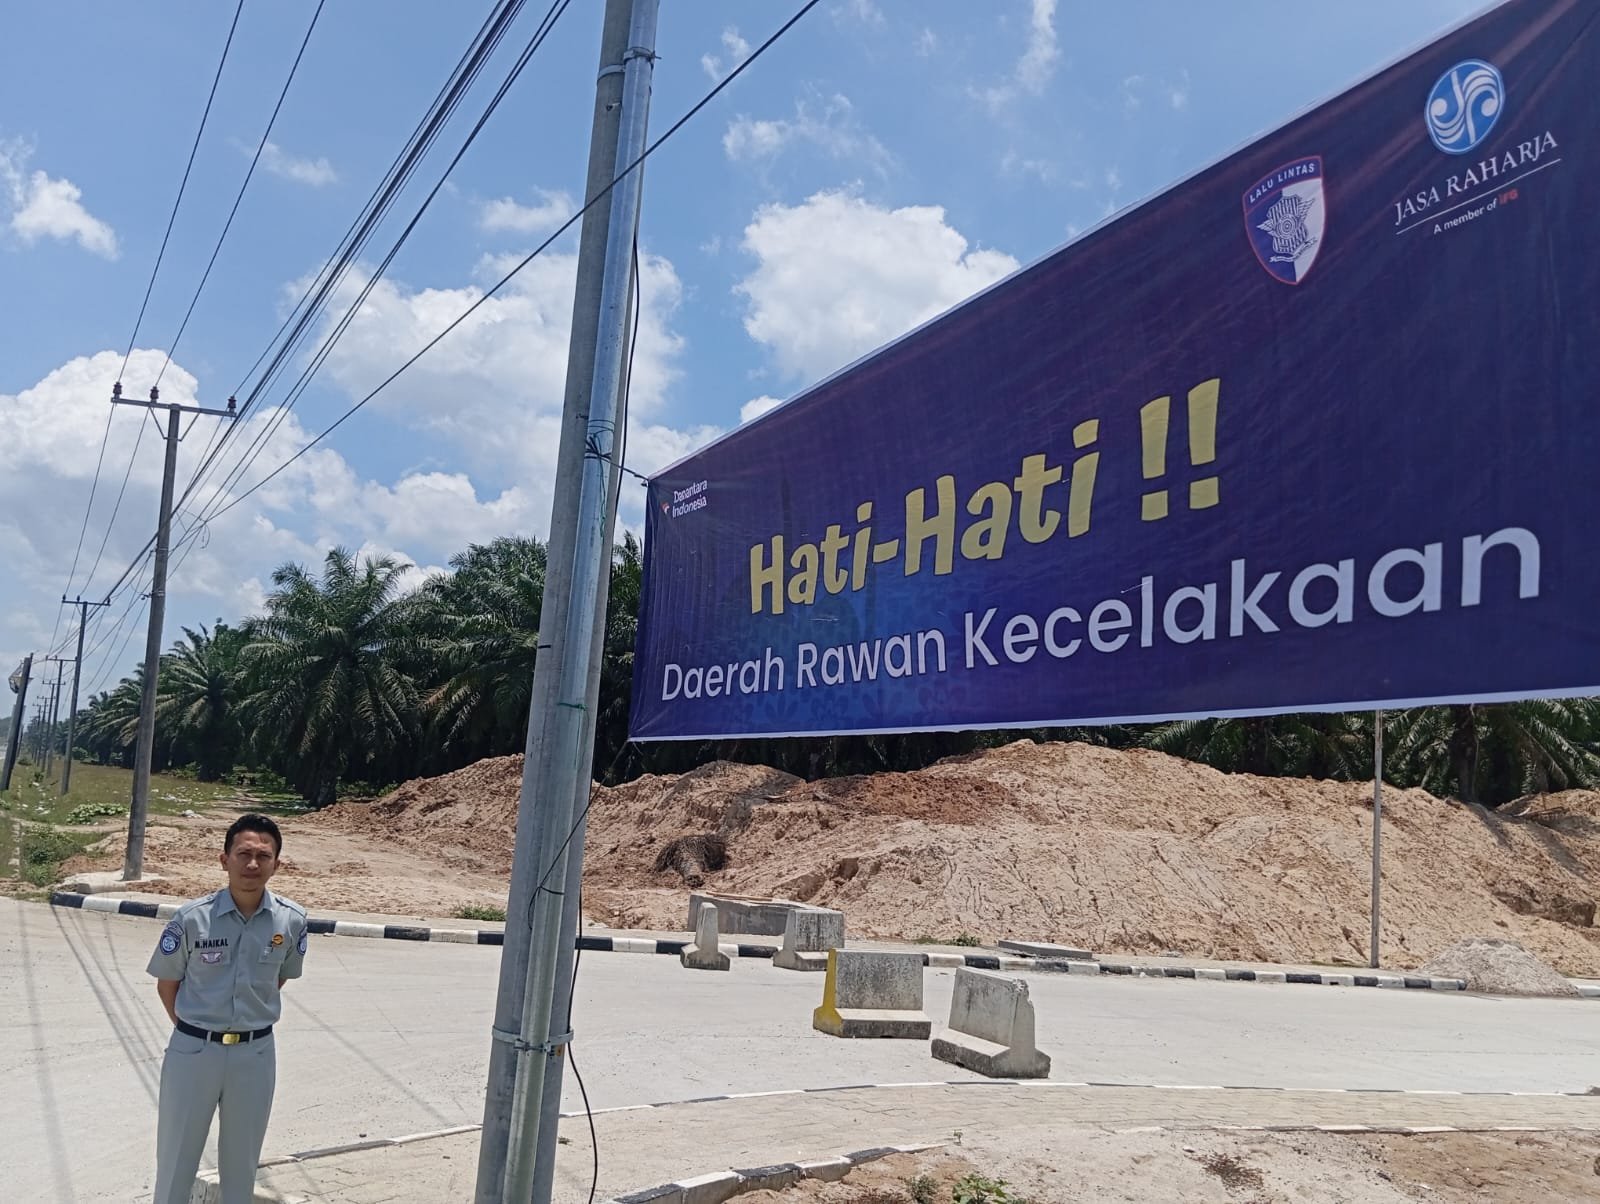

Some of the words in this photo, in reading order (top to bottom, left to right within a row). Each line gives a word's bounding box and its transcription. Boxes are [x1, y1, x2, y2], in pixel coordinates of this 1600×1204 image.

[1249, 178, 1274, 203] LALU
[1277, 163, 1316, 183] LINTAS
[1395, 186, 1440, 226] JASA
[1446, 130, 1558, 197] RAHARJA
[1433, 223, 1442, 235] A
[1444, 206, 1485, 230] member
[1486, 197, 1497, 211] of
[672, 494, 708, 518] Indonesia
[673, 480, 708, 504] Danantara
[750, 418, 1100, 615] Hati-Hati
[1140, 378, 1220, 521] !!
[661, 647, 785, 701] Daerah
[796, 627, 946, 689] Rawan
[964, 526, 1541, 669] Kecelakaan
